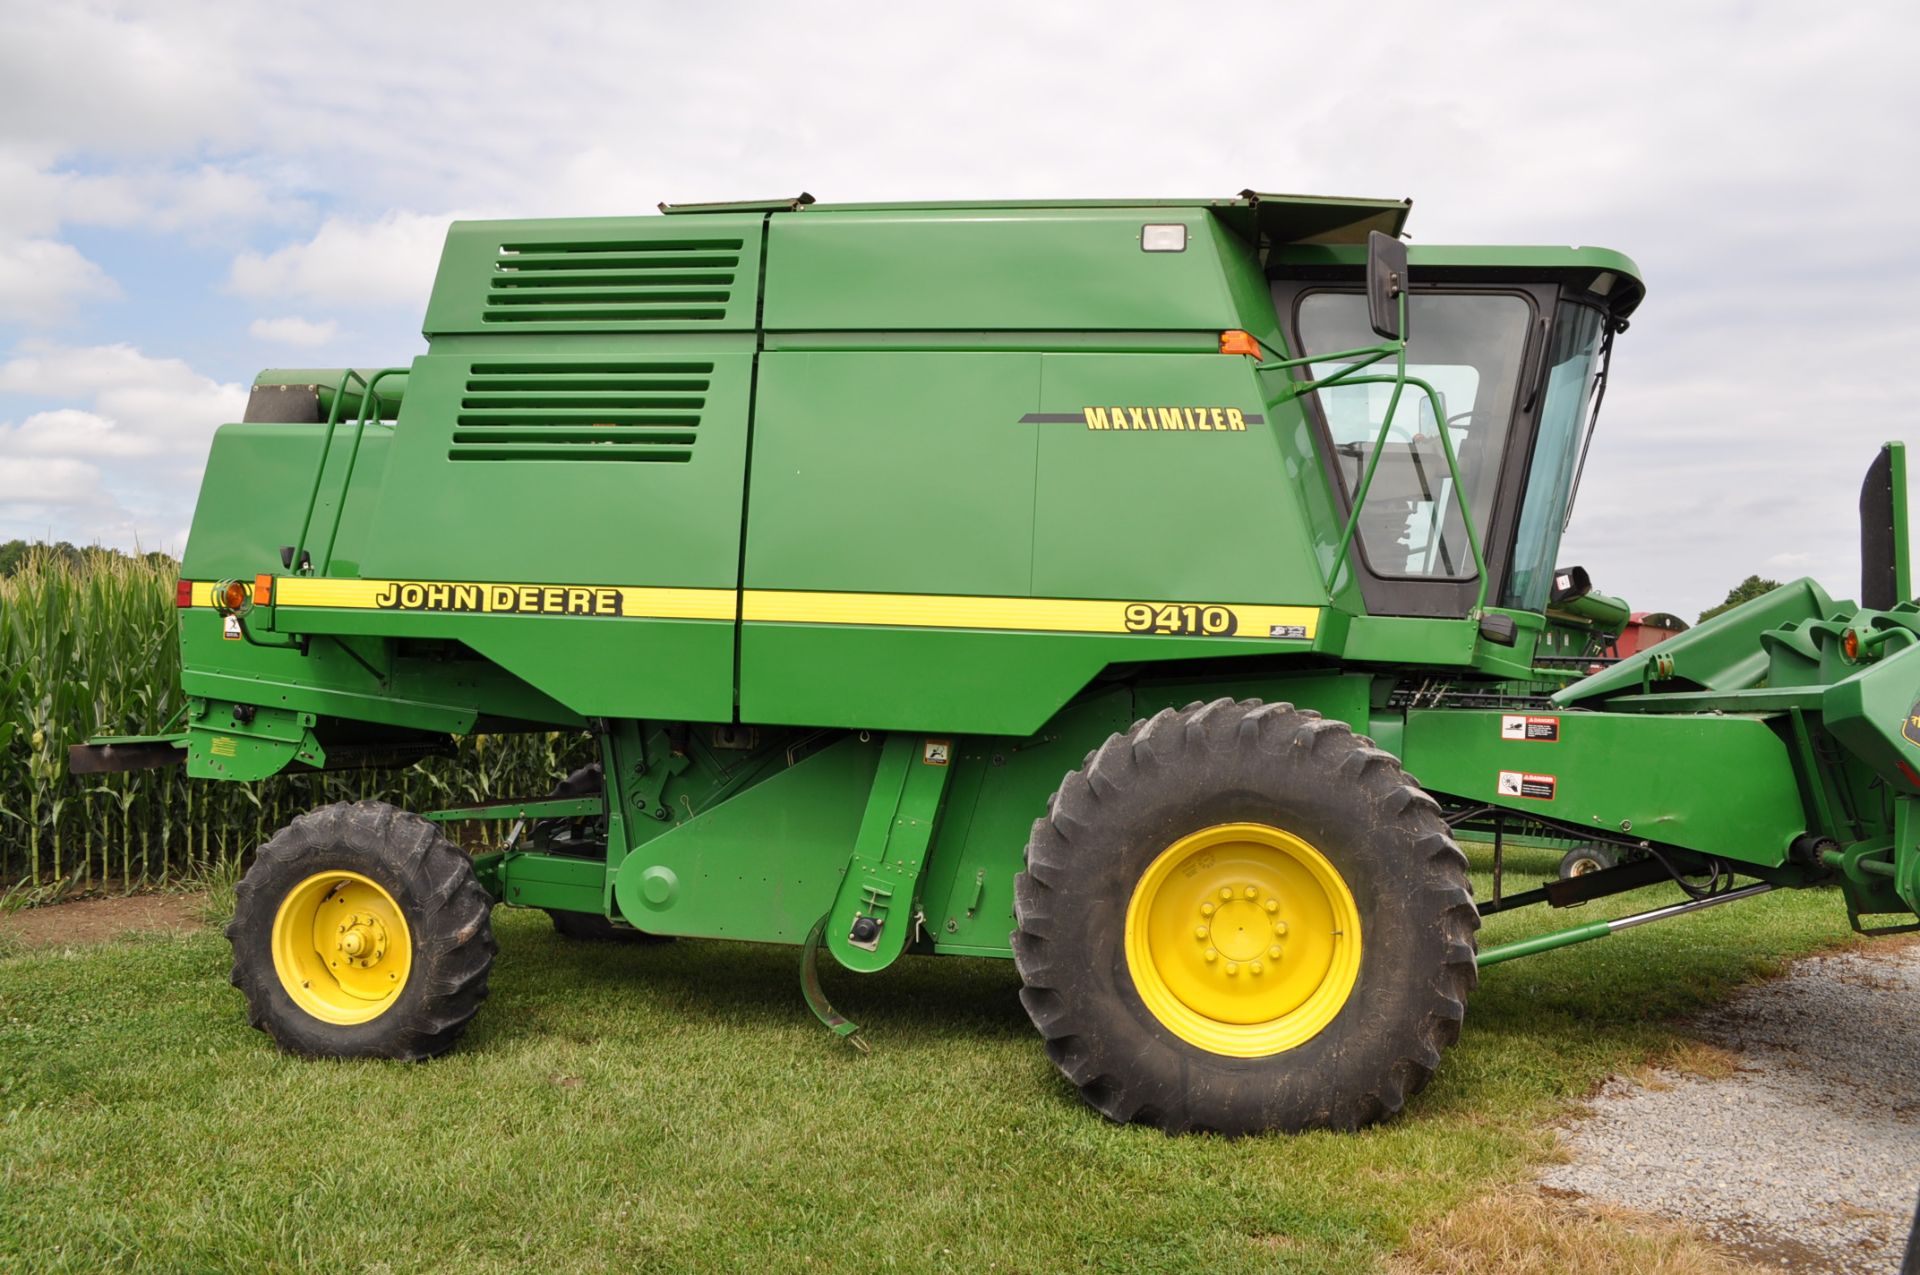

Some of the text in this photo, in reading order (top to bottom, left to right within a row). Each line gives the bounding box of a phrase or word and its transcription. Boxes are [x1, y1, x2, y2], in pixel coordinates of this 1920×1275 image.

[1084, 407, 1247, 431] MAXIMIZER
[376, 583, 623, 616] JOHN DEERE
[1125, 604, 1238, 636] 9410
